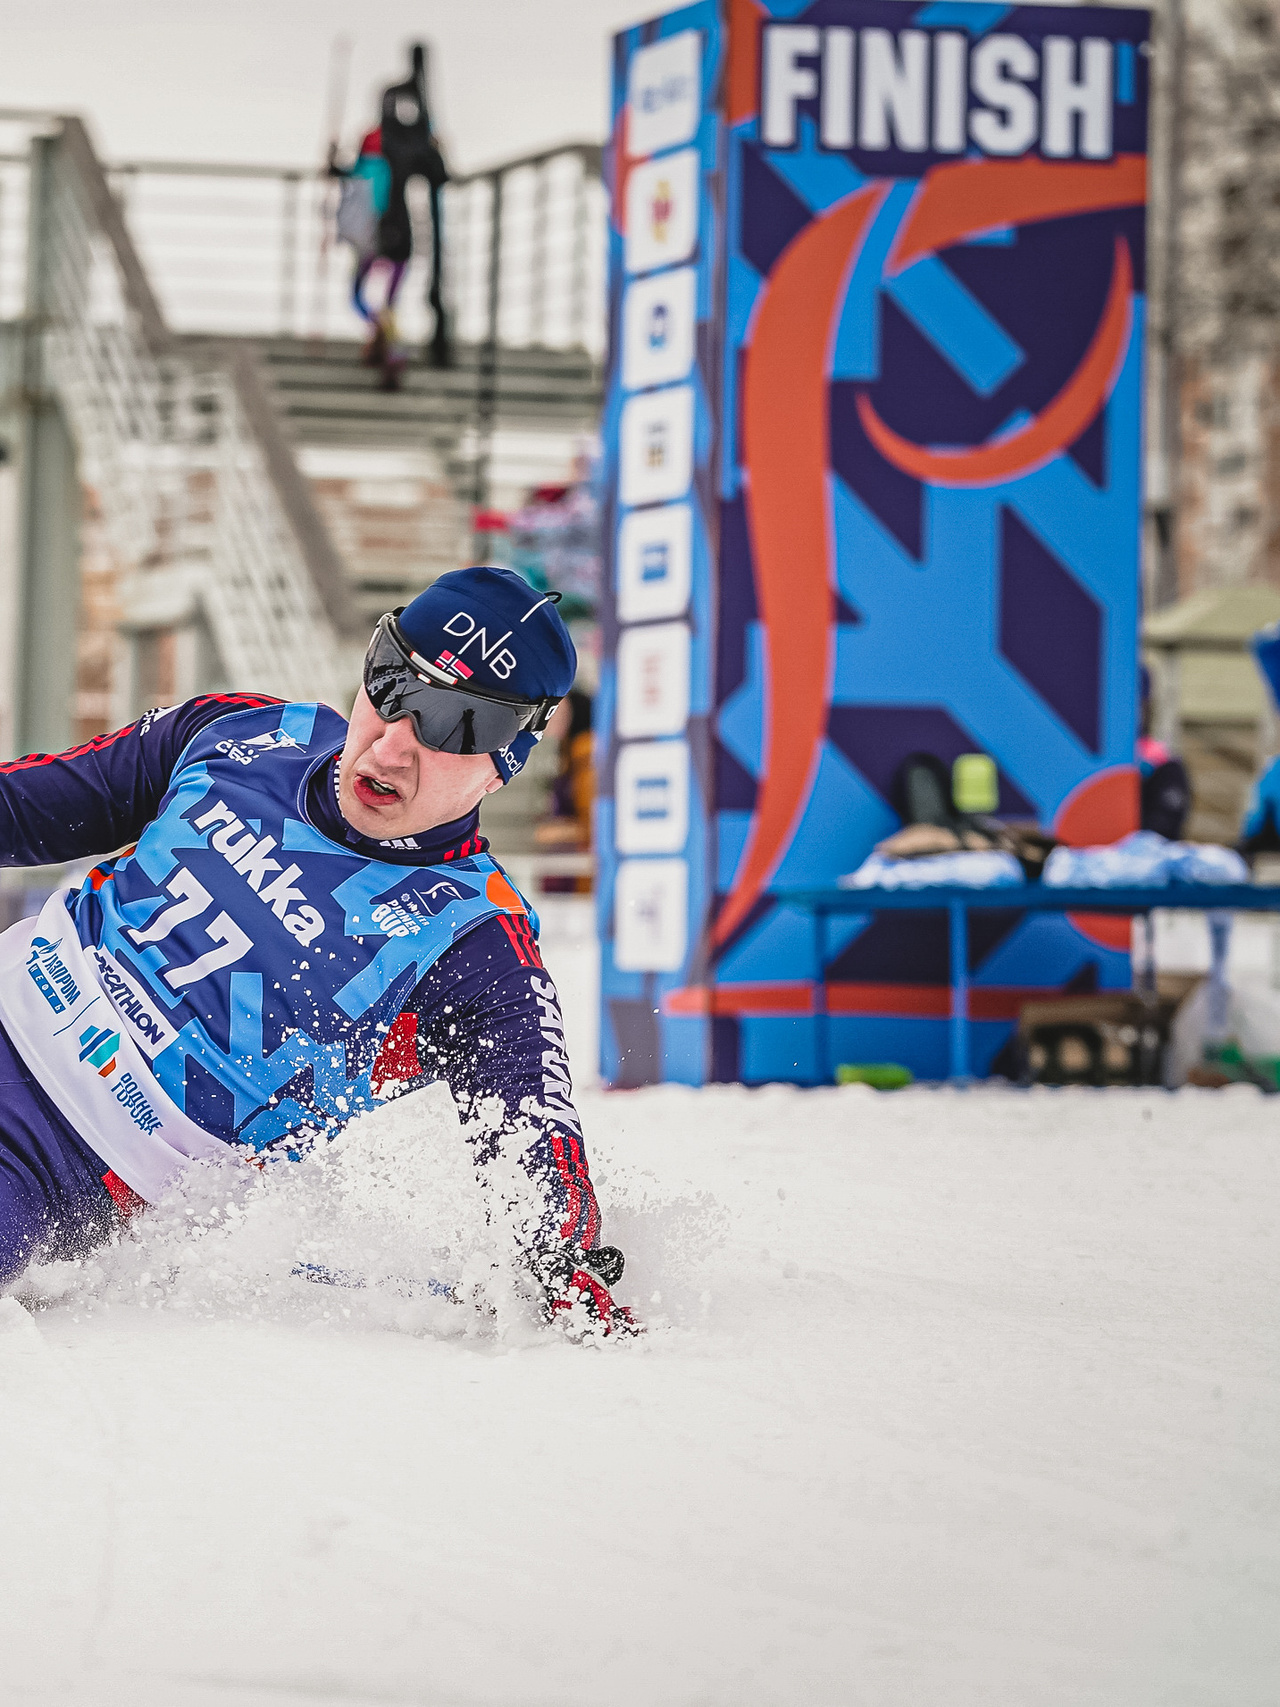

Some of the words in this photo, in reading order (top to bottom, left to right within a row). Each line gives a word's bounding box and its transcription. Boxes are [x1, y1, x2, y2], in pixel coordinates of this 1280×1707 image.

[761, 24, 1113, 159] FINISH
[442, 611, 517, 680] DNB
[128, 867, 253, 990] 77
[193, 800, 325, 947] rukka
[387, 899, 422, 934] PIONER
